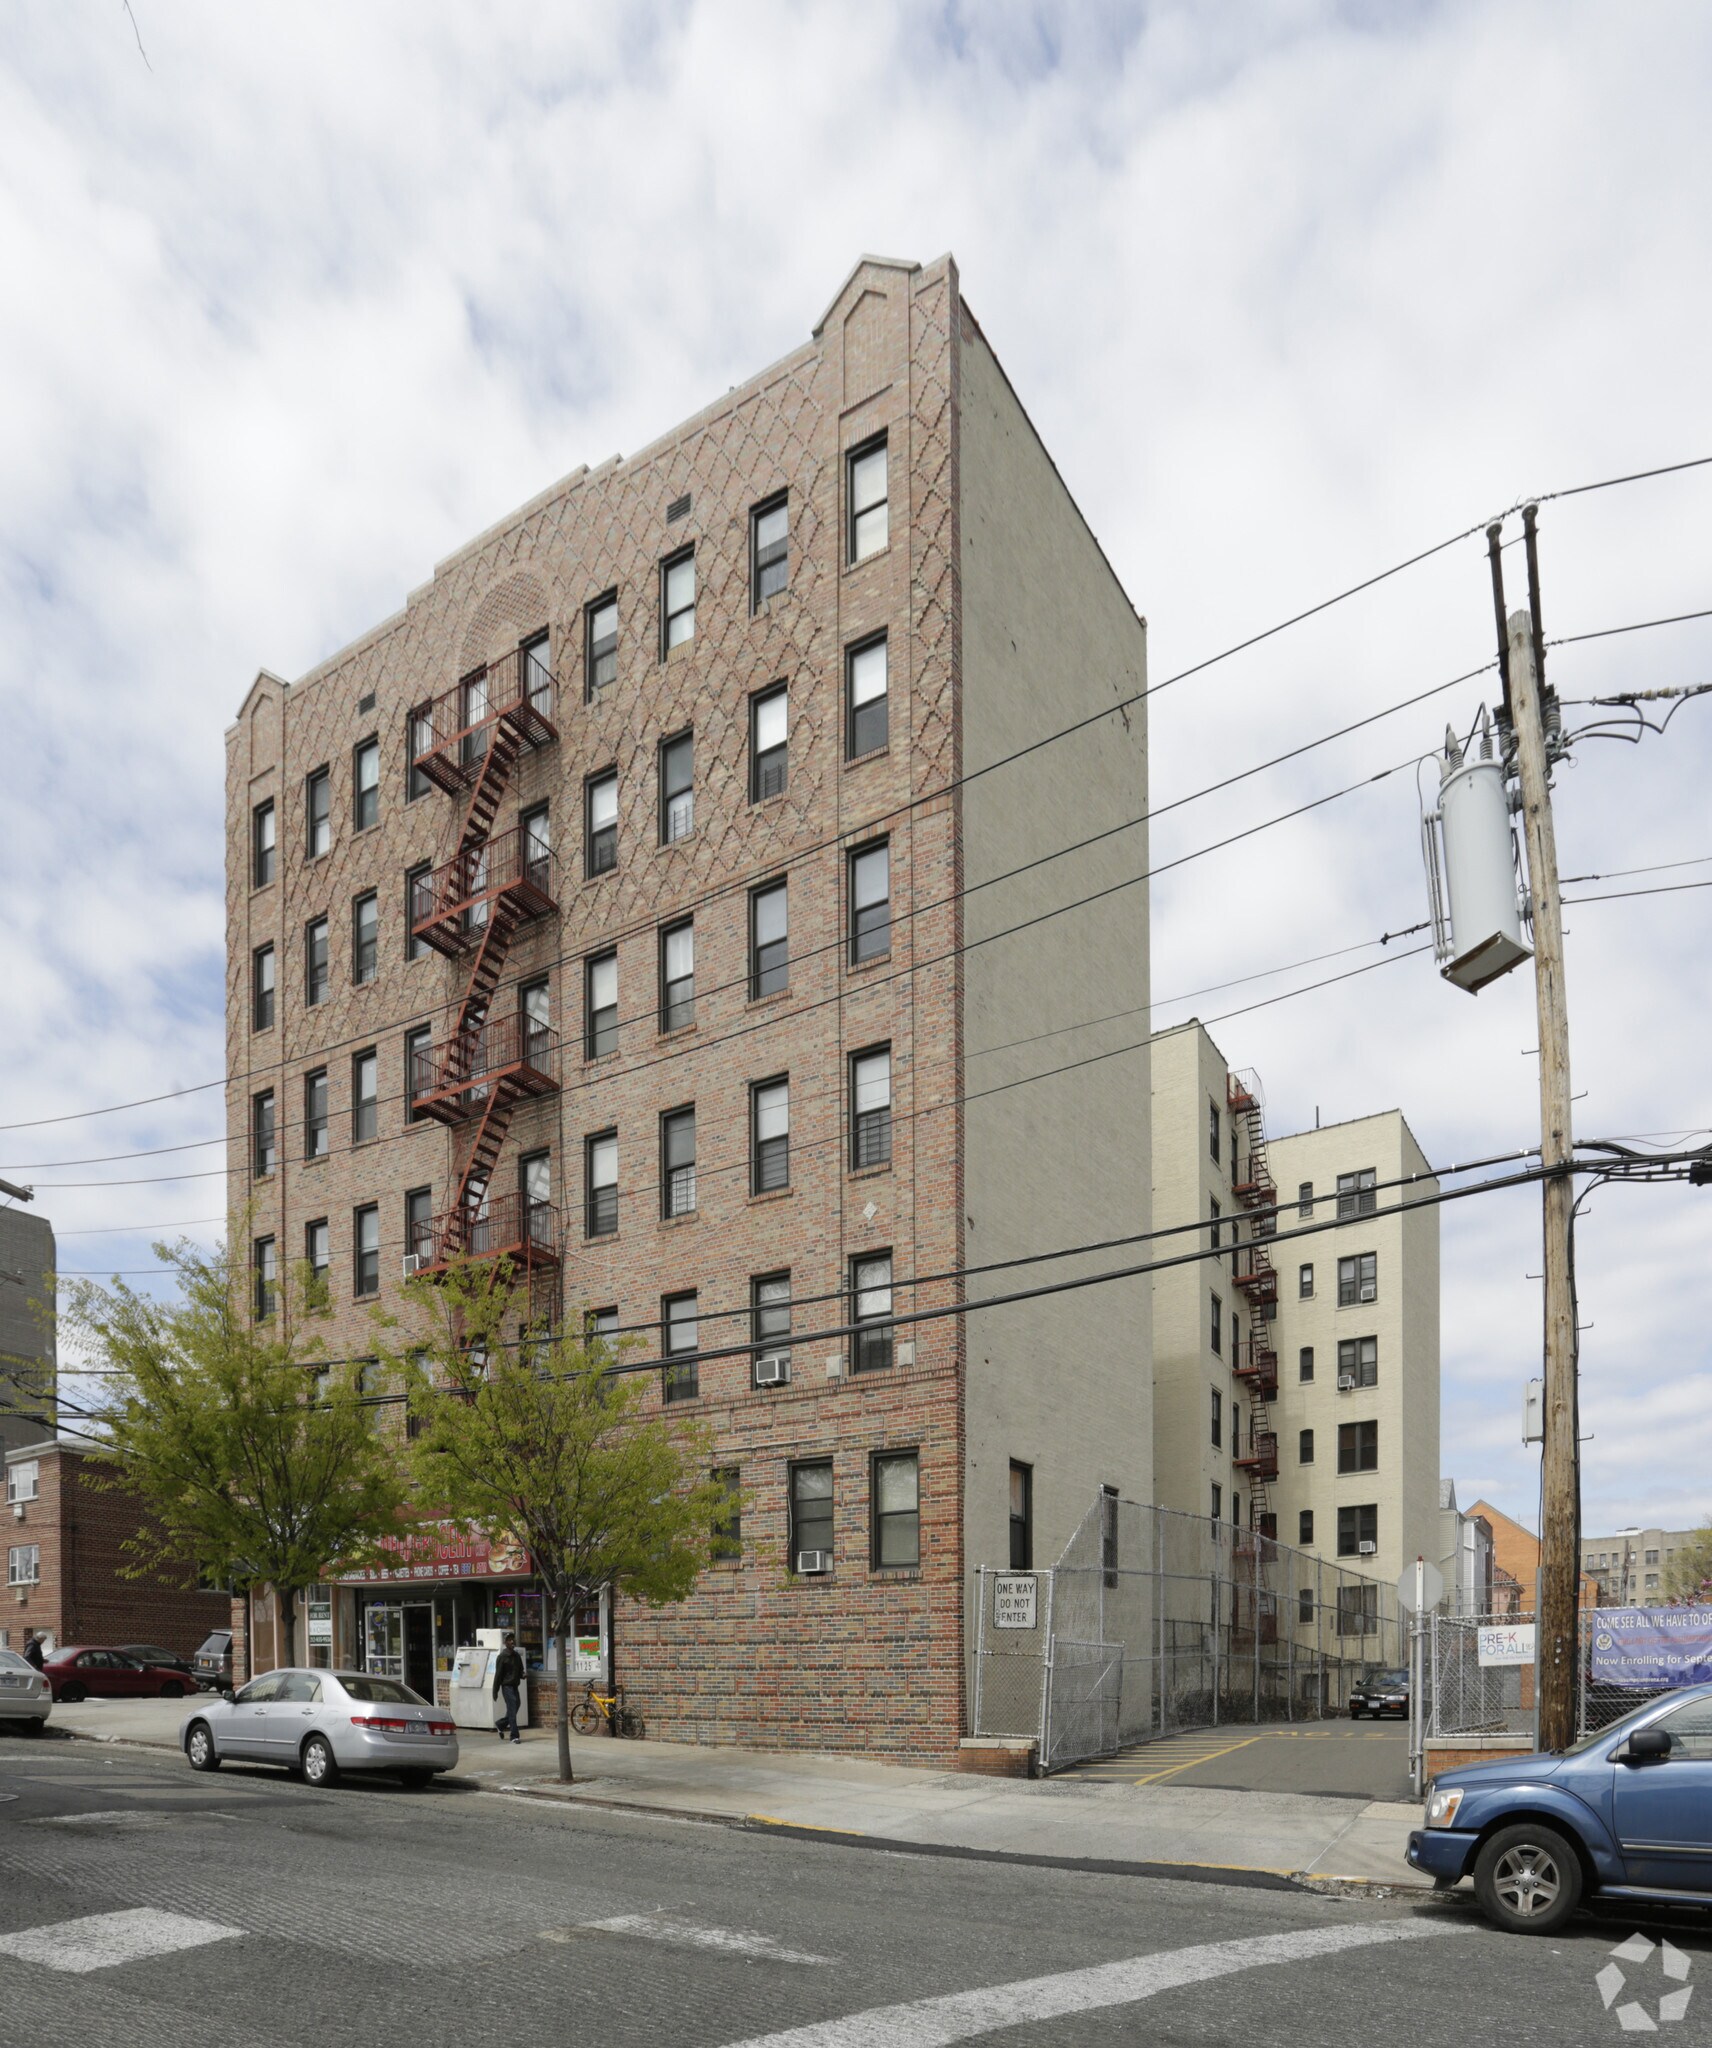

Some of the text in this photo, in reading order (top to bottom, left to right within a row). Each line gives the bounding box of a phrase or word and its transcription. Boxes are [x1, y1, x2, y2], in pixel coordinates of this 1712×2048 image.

[997, 1583, 1035, 1594] ONE WAY
[495, 1600, 513, 1608] ATM
[1000, 1598, 1030, 1609] DO NOT
[1001, 1612, 1027, 1622] ENTER
[1596, 1616, 1619, 1630] COME
[1620, 1615, 1634, 1629] SEE
[1636, 1615, 1650, 1628] ALL
[1651, 1614, 1664, 1628] WE
[1666, 1613, 1687, 1627] HAVE
[1688, 1613, 1700, 1626] TO
[1479, 1631, 1518, 1645] PRE-K
[1596, 1654, 1712, 1667] Now Enrolling for Septe
